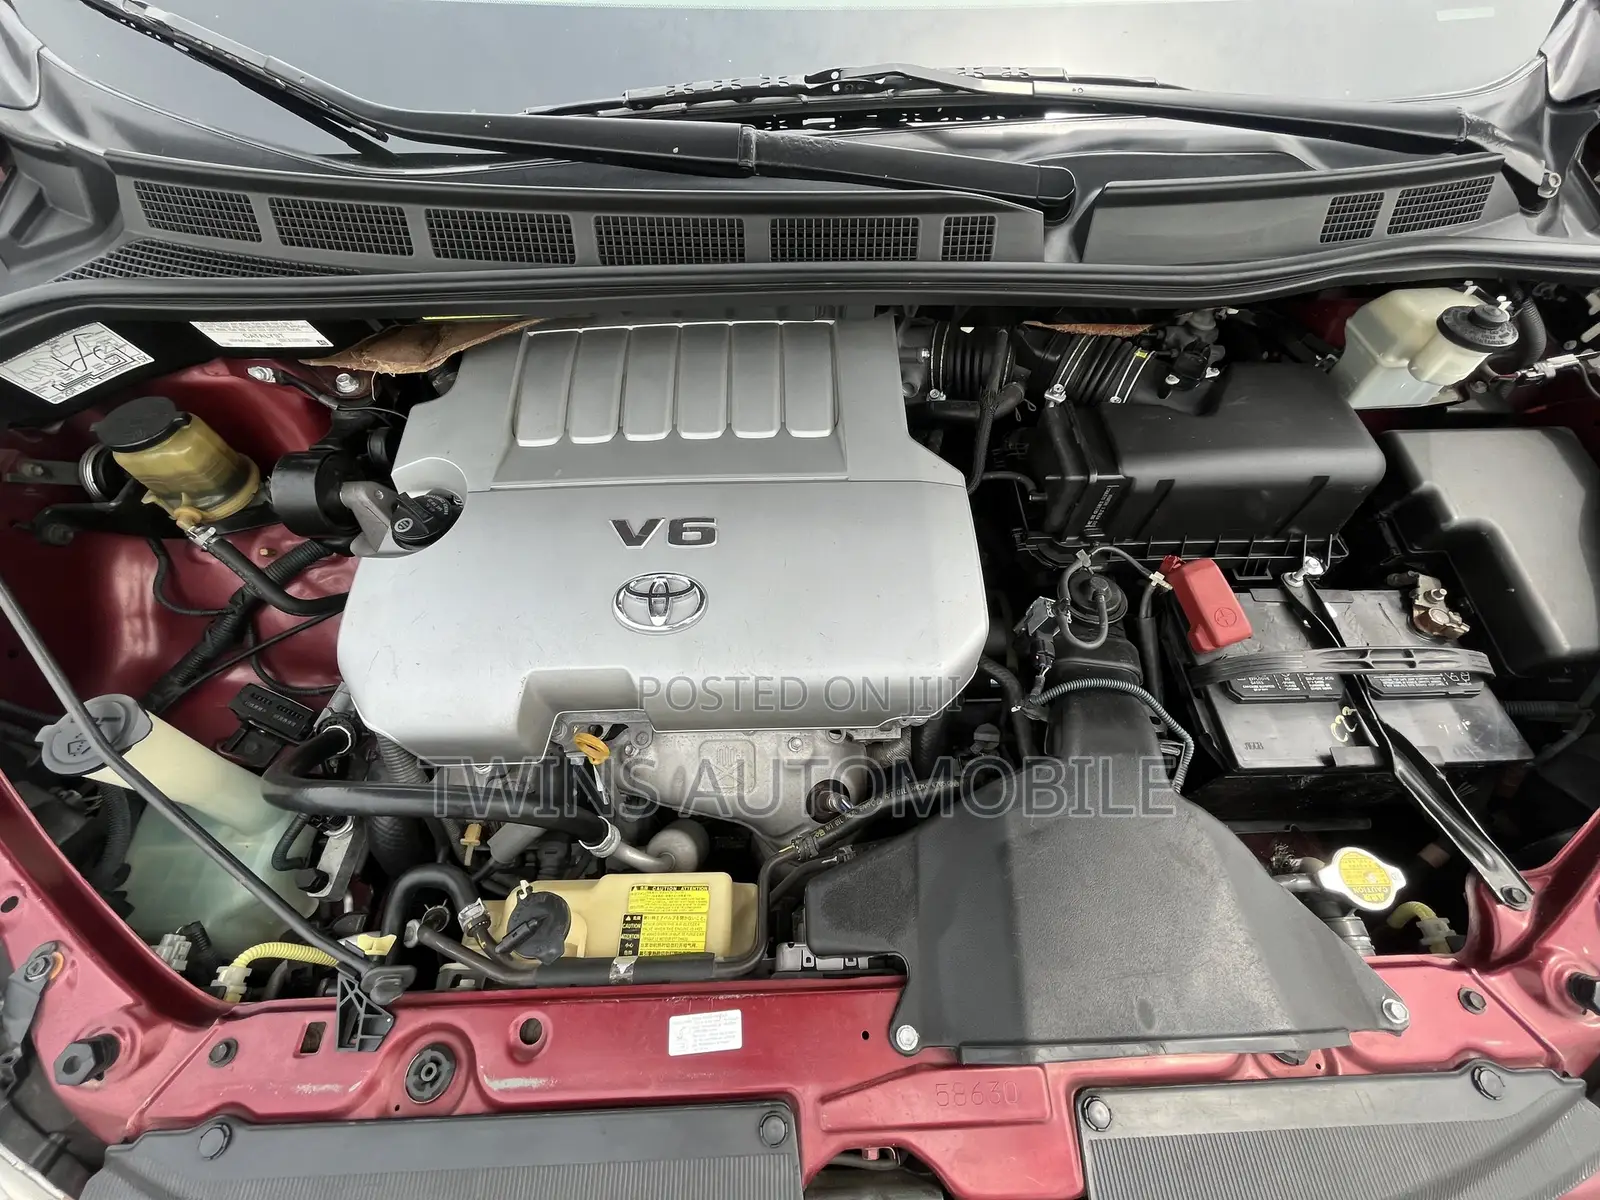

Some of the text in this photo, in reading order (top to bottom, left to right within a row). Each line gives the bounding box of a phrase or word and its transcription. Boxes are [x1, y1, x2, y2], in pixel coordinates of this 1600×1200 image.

[609, 517, 719, 549] V6
[1353, 886, 1388, 894] CAUTION
[935, 1080, 1019, 1107] 58630
